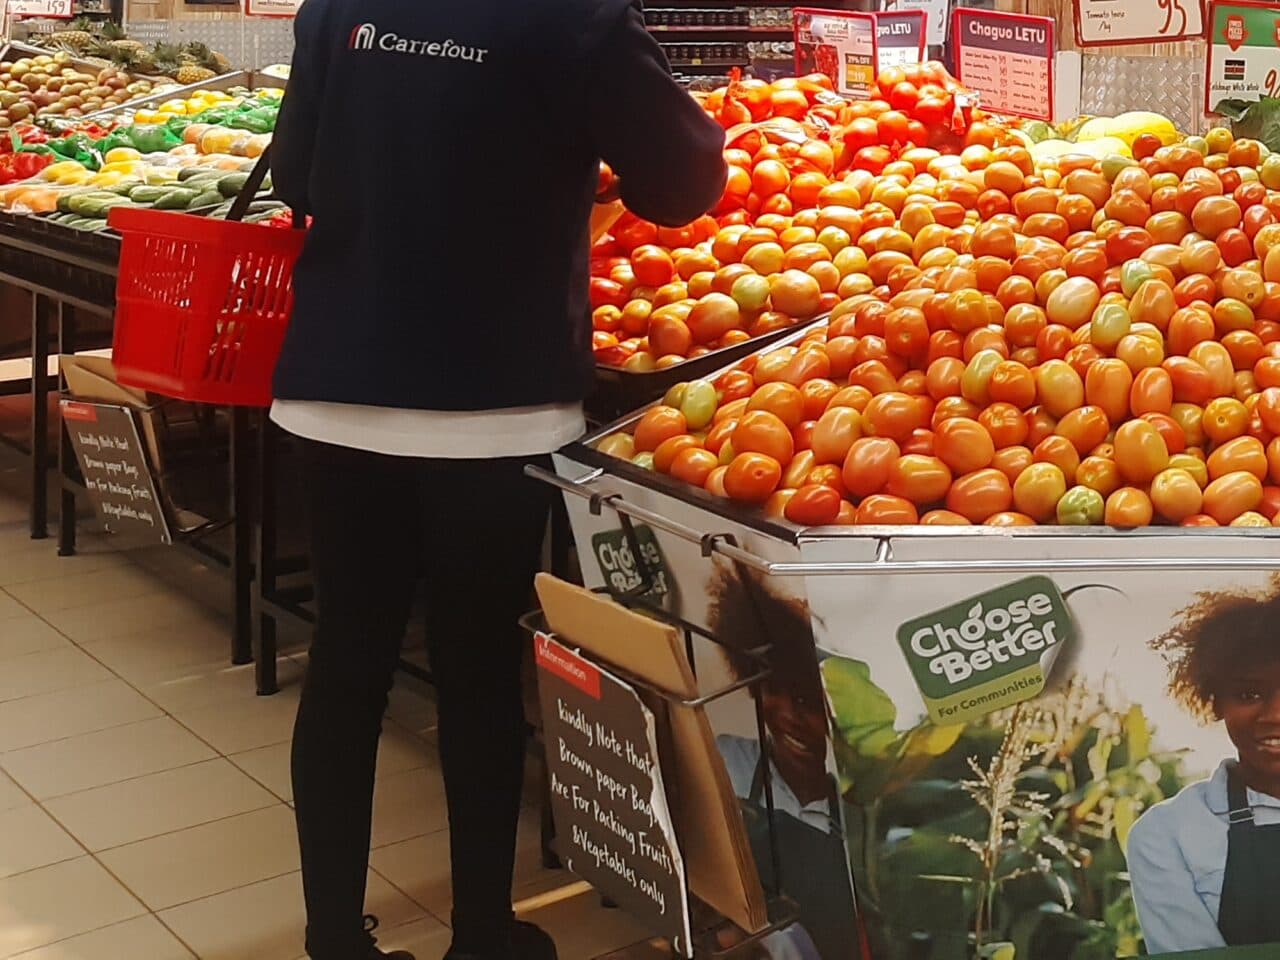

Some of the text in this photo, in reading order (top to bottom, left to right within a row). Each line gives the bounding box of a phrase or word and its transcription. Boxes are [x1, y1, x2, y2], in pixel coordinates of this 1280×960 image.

[378, 33, 489, 64] Carrefour
[890, 23, 912, 35] LETU
[969, 20, 1045, 44] Chaguo LETU
[598, 535, 660, 577] Chose
[910, 593, 1053, 657] Choose
[538, 643, 587, 681] Information
[929, 620, 1057, 684] Better
[938, 674, 1043, 719] For Communities
[596, 722, 623, 757] Note
[626, 740, 652, 777] that
[558, 737, 655, 828] Brown paper Bag
[551, 772, 673, 875] Are For Packing Fruits
[640, 878, 665, 915] only
